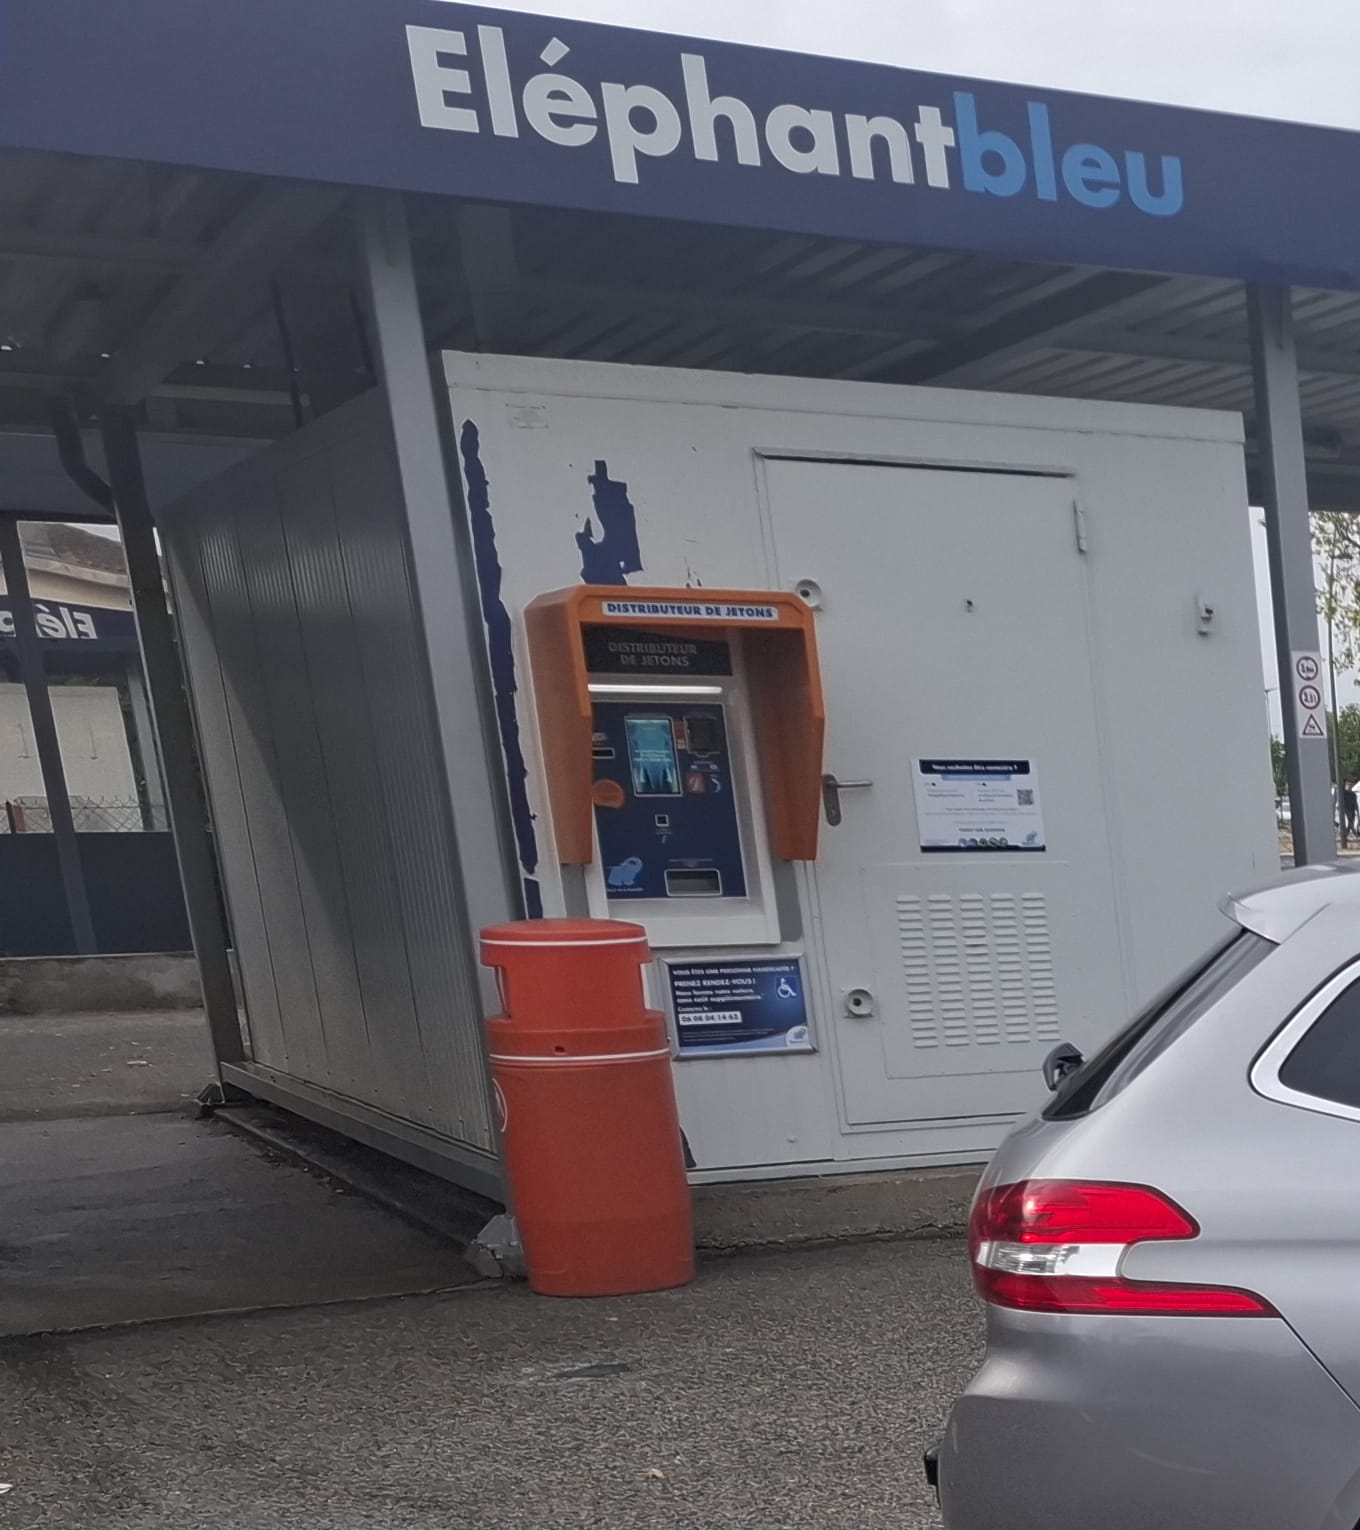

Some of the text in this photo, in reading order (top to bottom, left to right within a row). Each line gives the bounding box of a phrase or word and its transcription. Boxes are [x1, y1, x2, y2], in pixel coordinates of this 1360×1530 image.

[607, 603, 773, 618] DISTRIBUTEUR DE JETONS
[608, 642, 697, 655] DISTRIBUTEUR
[620, 655, 689, 667] DE JETONS
